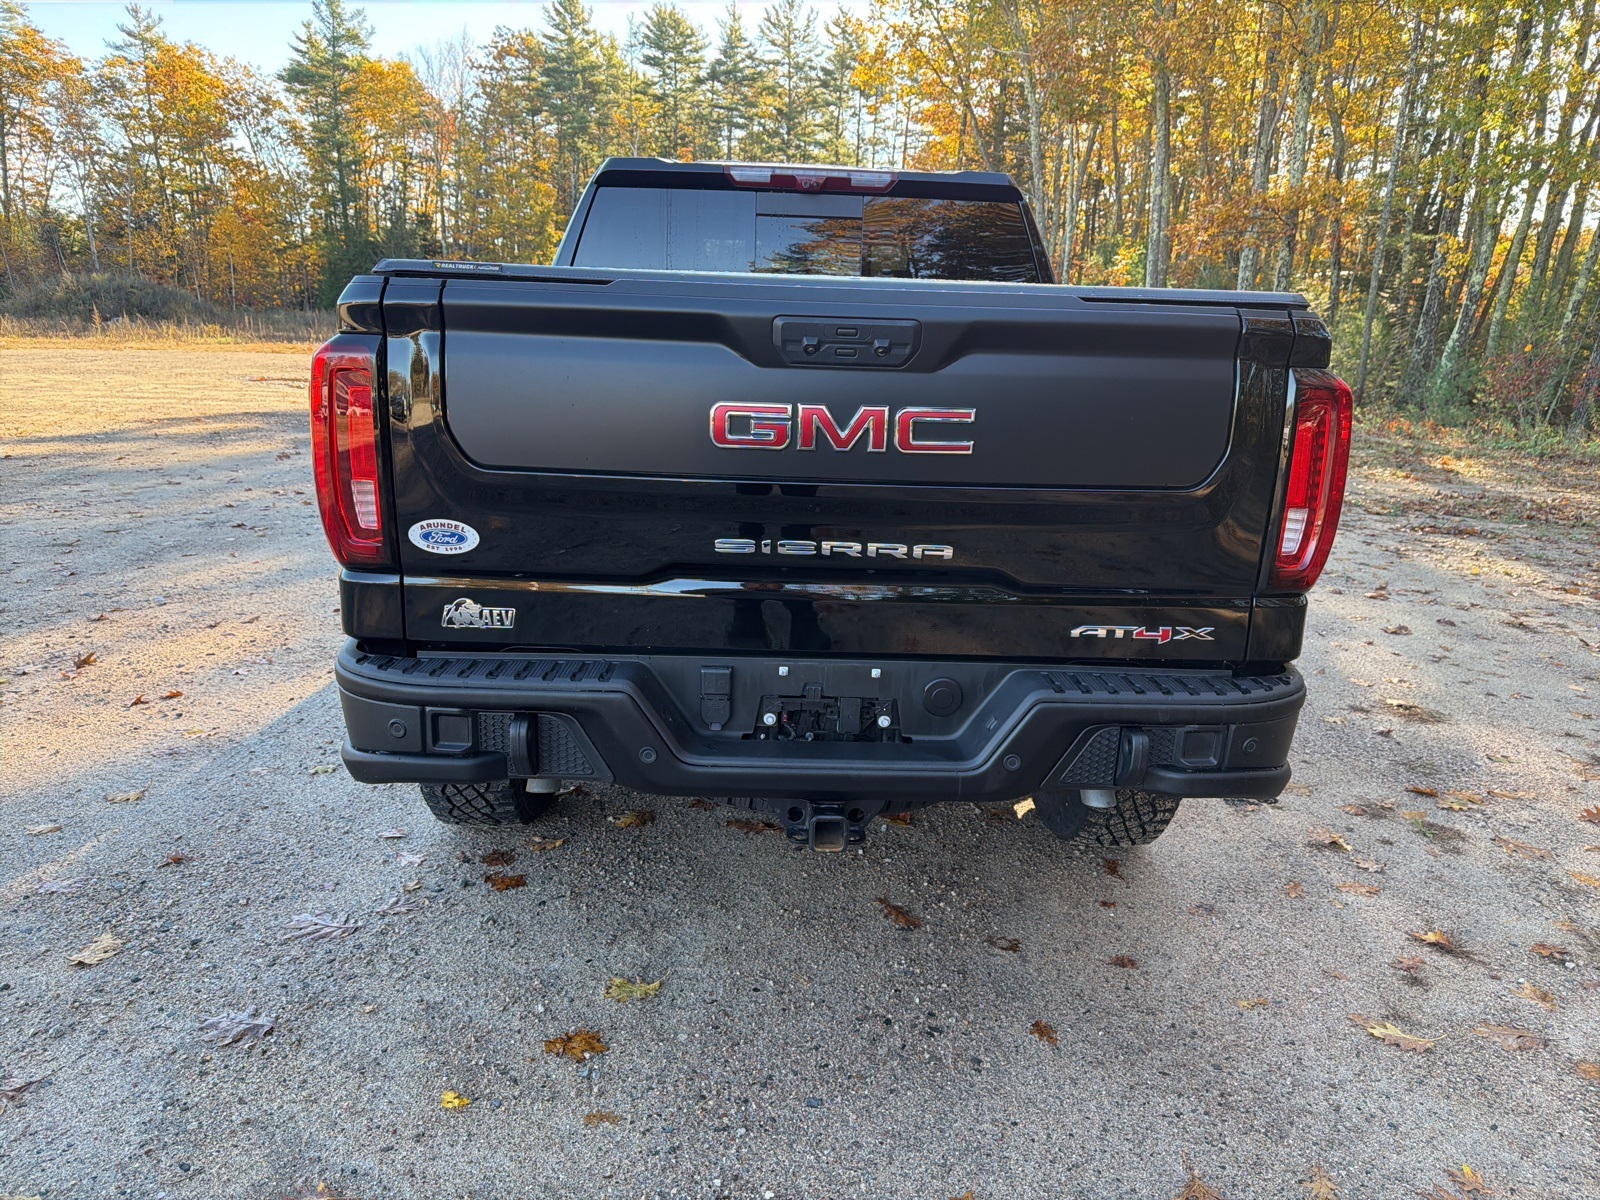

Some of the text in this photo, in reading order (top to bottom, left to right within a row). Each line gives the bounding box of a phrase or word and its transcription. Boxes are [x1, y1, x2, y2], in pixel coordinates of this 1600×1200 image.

[709, 401, 977, 454] GMC
[420, 522, 467, 534] ARUNDEL
[428, 531, 459, 544] Ford
[714, 538, 954, 560] SIERRA
[482, 609, 514, 626] AEV
[1070, 625, 1216, 645] AT4X
